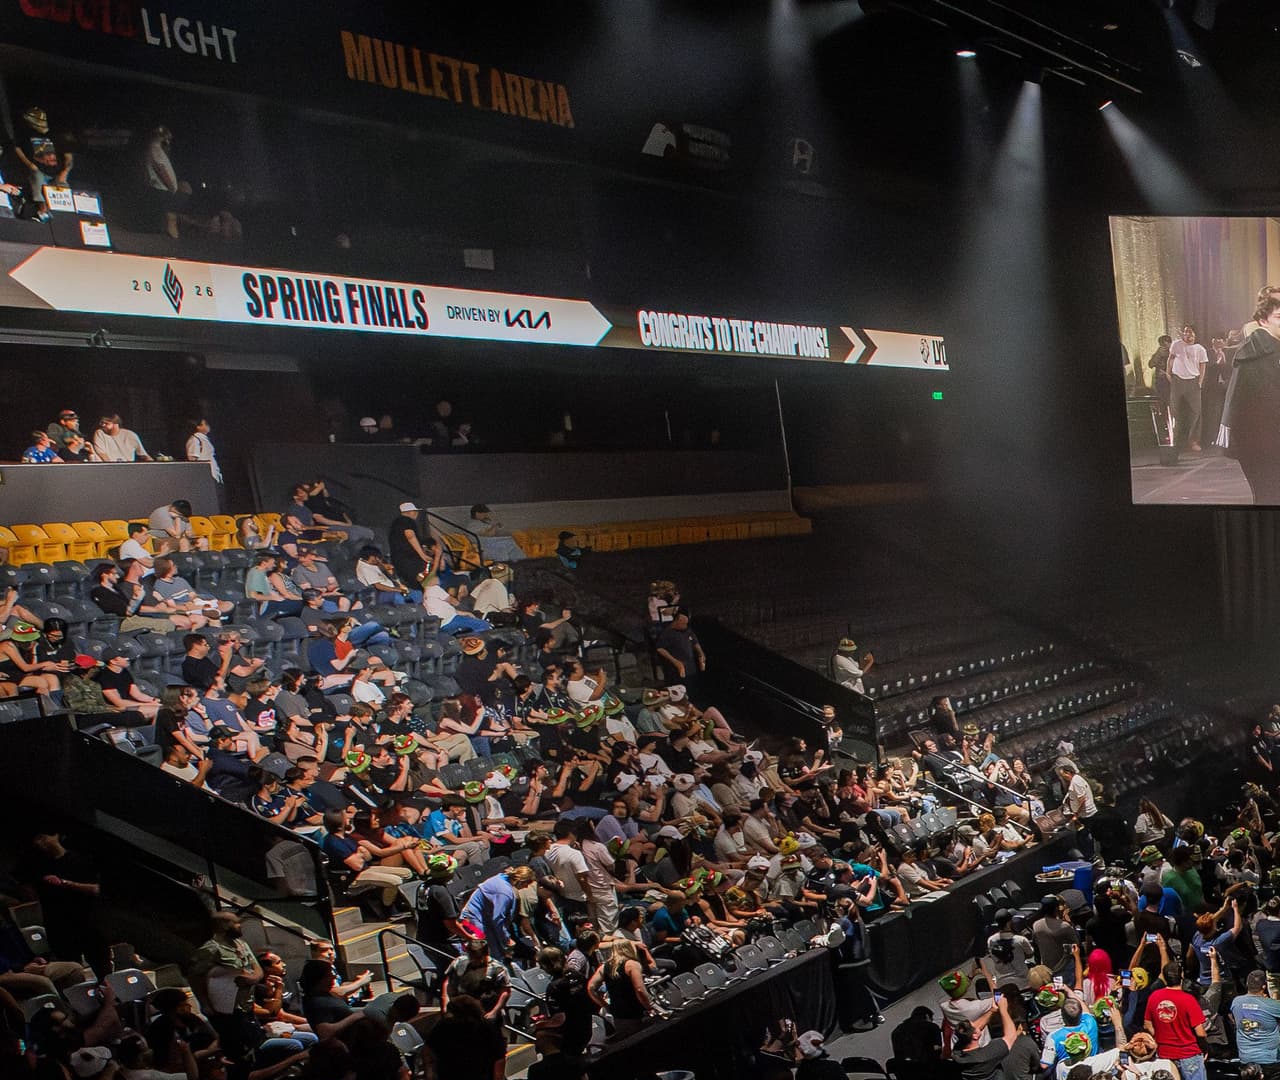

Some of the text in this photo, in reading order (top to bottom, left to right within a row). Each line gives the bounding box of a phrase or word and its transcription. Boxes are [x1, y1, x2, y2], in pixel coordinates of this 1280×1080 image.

[140, 8, 238, 63] LIGHT
[339, 29, 576, 129] MULLETT ARENA
[242, 272, 429, 331] SPRING FINALS
[447, 305, 552, 330] DRIVEN BY KIA
[637, 309, 831, 359] CONGRATS TO THE CHAMPIONS!
